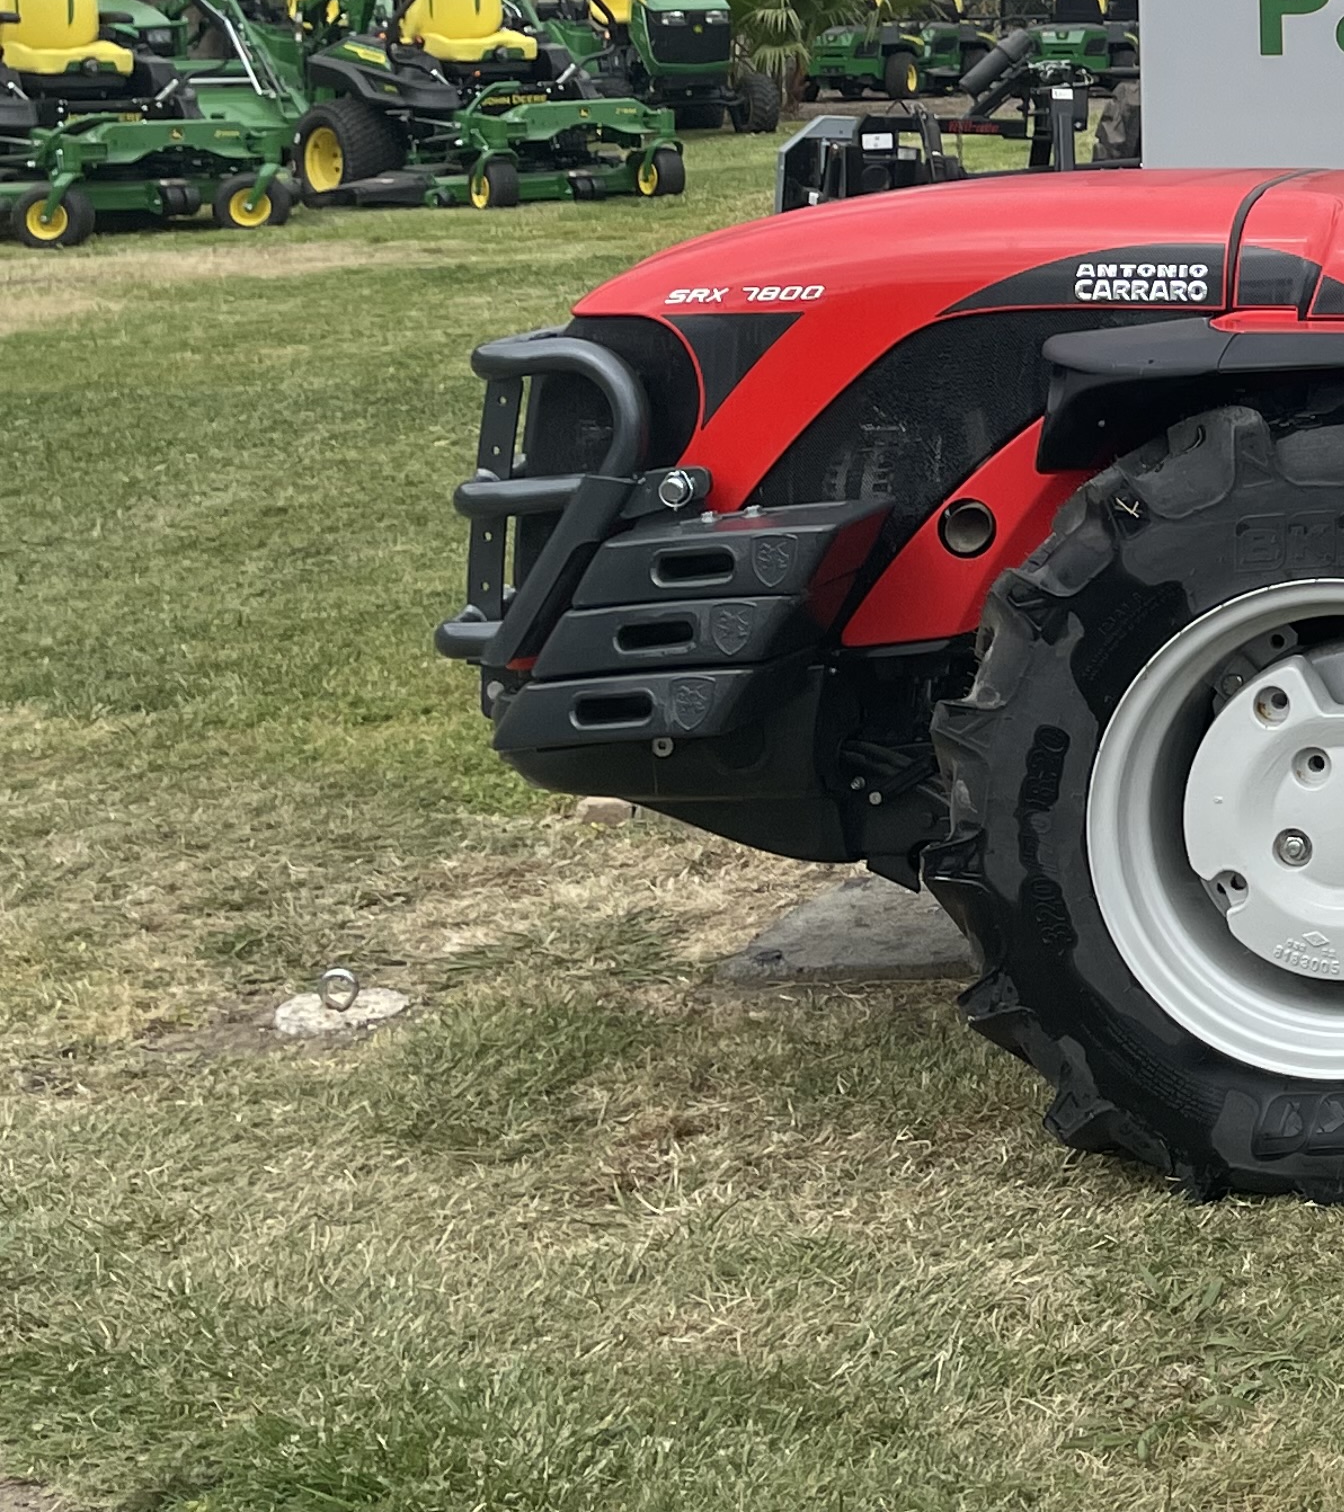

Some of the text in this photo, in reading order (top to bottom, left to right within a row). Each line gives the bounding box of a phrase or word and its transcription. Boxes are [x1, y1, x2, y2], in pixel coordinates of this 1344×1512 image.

[1076, 263, 1209, 278] ANTONIO
[664, 285, 825, 304] SRX 7800
[1074, 279, 1208, 301] CARRARO
